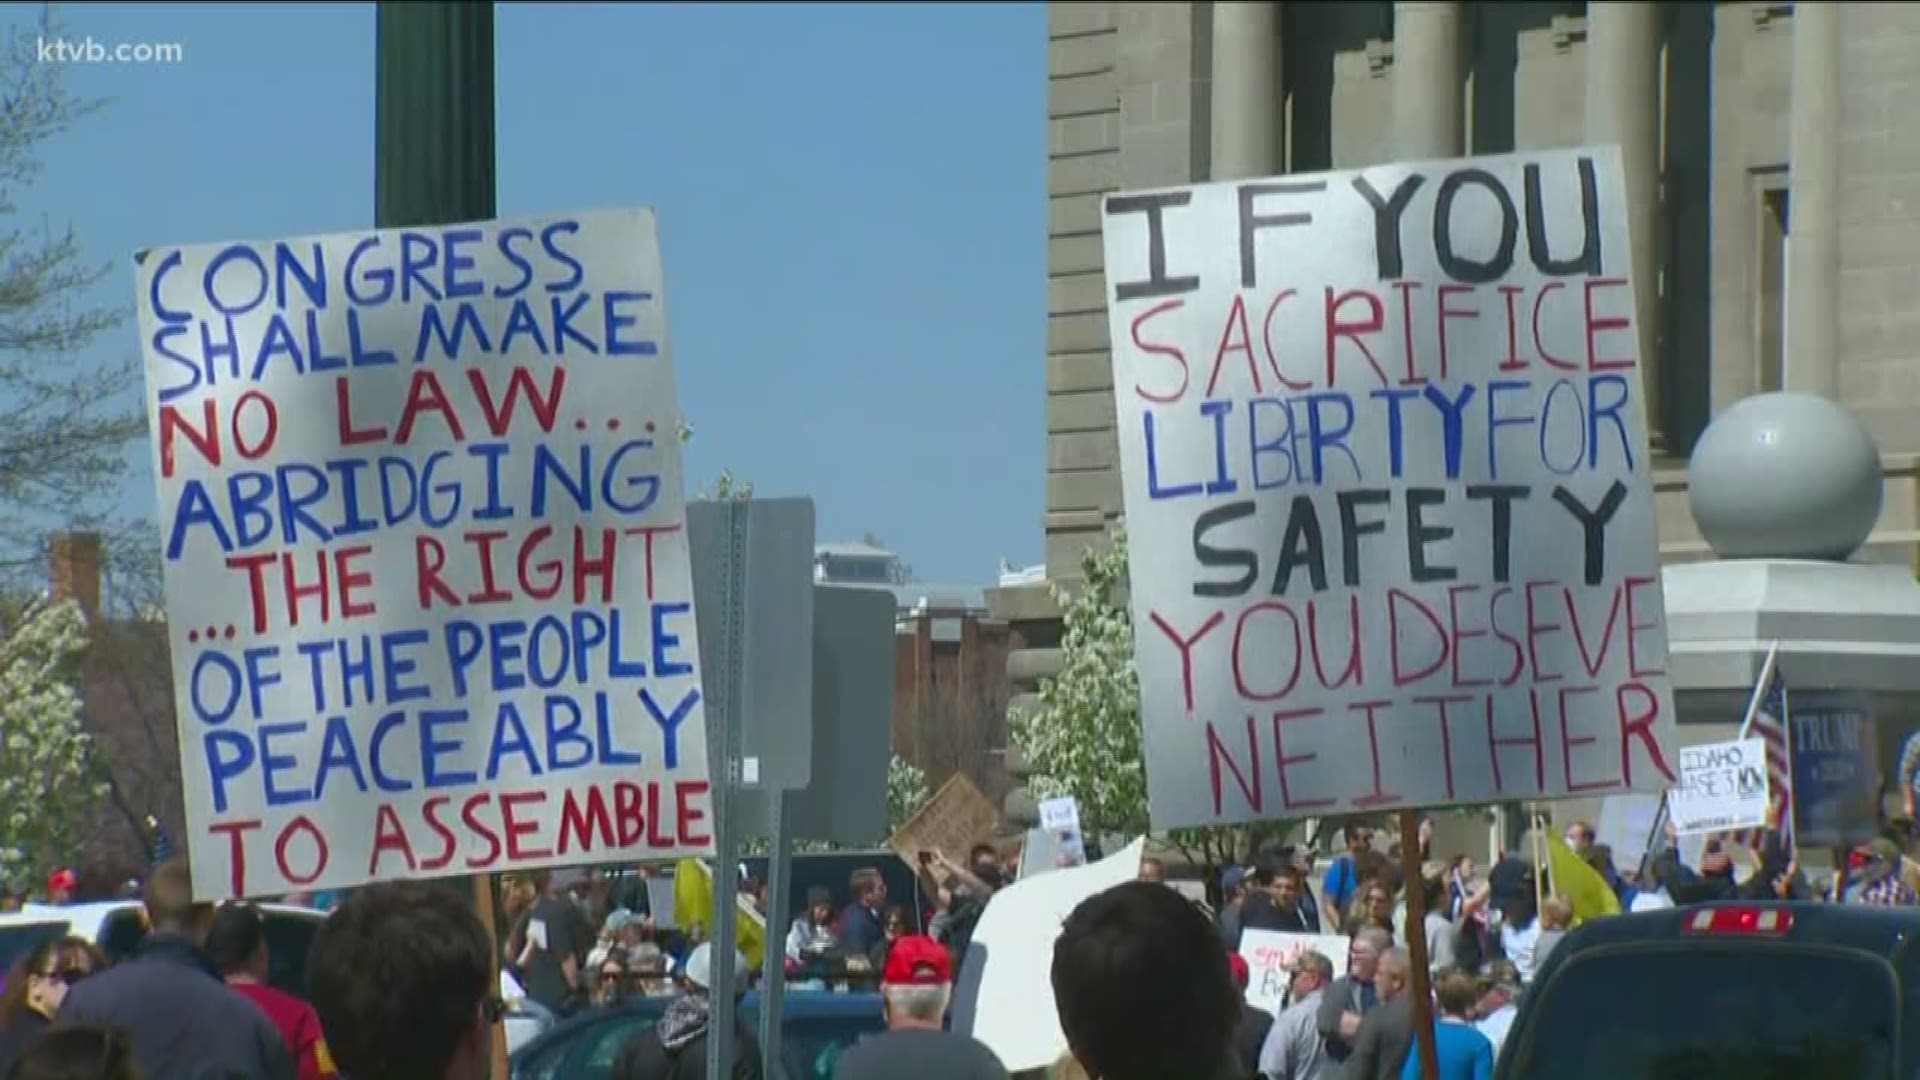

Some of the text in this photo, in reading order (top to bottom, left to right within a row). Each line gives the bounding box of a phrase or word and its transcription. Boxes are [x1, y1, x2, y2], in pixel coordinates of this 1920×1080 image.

[150, 220, 584, 324] CONGRESS
[1104, 157, 1602, 301] IF YOU
[152, 291, 657, 401] SHALL MAKE
[1131, 277, 1636, 404] SACRIFICE
[158, 390, 279, 478] NO
[1143, 375, 1633, 499] LIBERTY FOR
[166, 440, 659, 560] ABRIDGING
[1192, 480, 1628, 599] SAFETY
[416, 524, 682, 610] RIGHT
[190, 603, 694, 725] OF THE PEOPLE
[1150, 576, 1666, 719] YOU DESEVE
[203, 688, 700, 813] PEACEABLY
[1205, 683, 1676, 817] NEITHER
[1680, 770, 1720, 798] HASE
[1682, 746, 1743, 772] IDAHO
[1793, 714, 1860, 751] TRUM
[208, 780, 711, 898] TO ASSEMBLE
